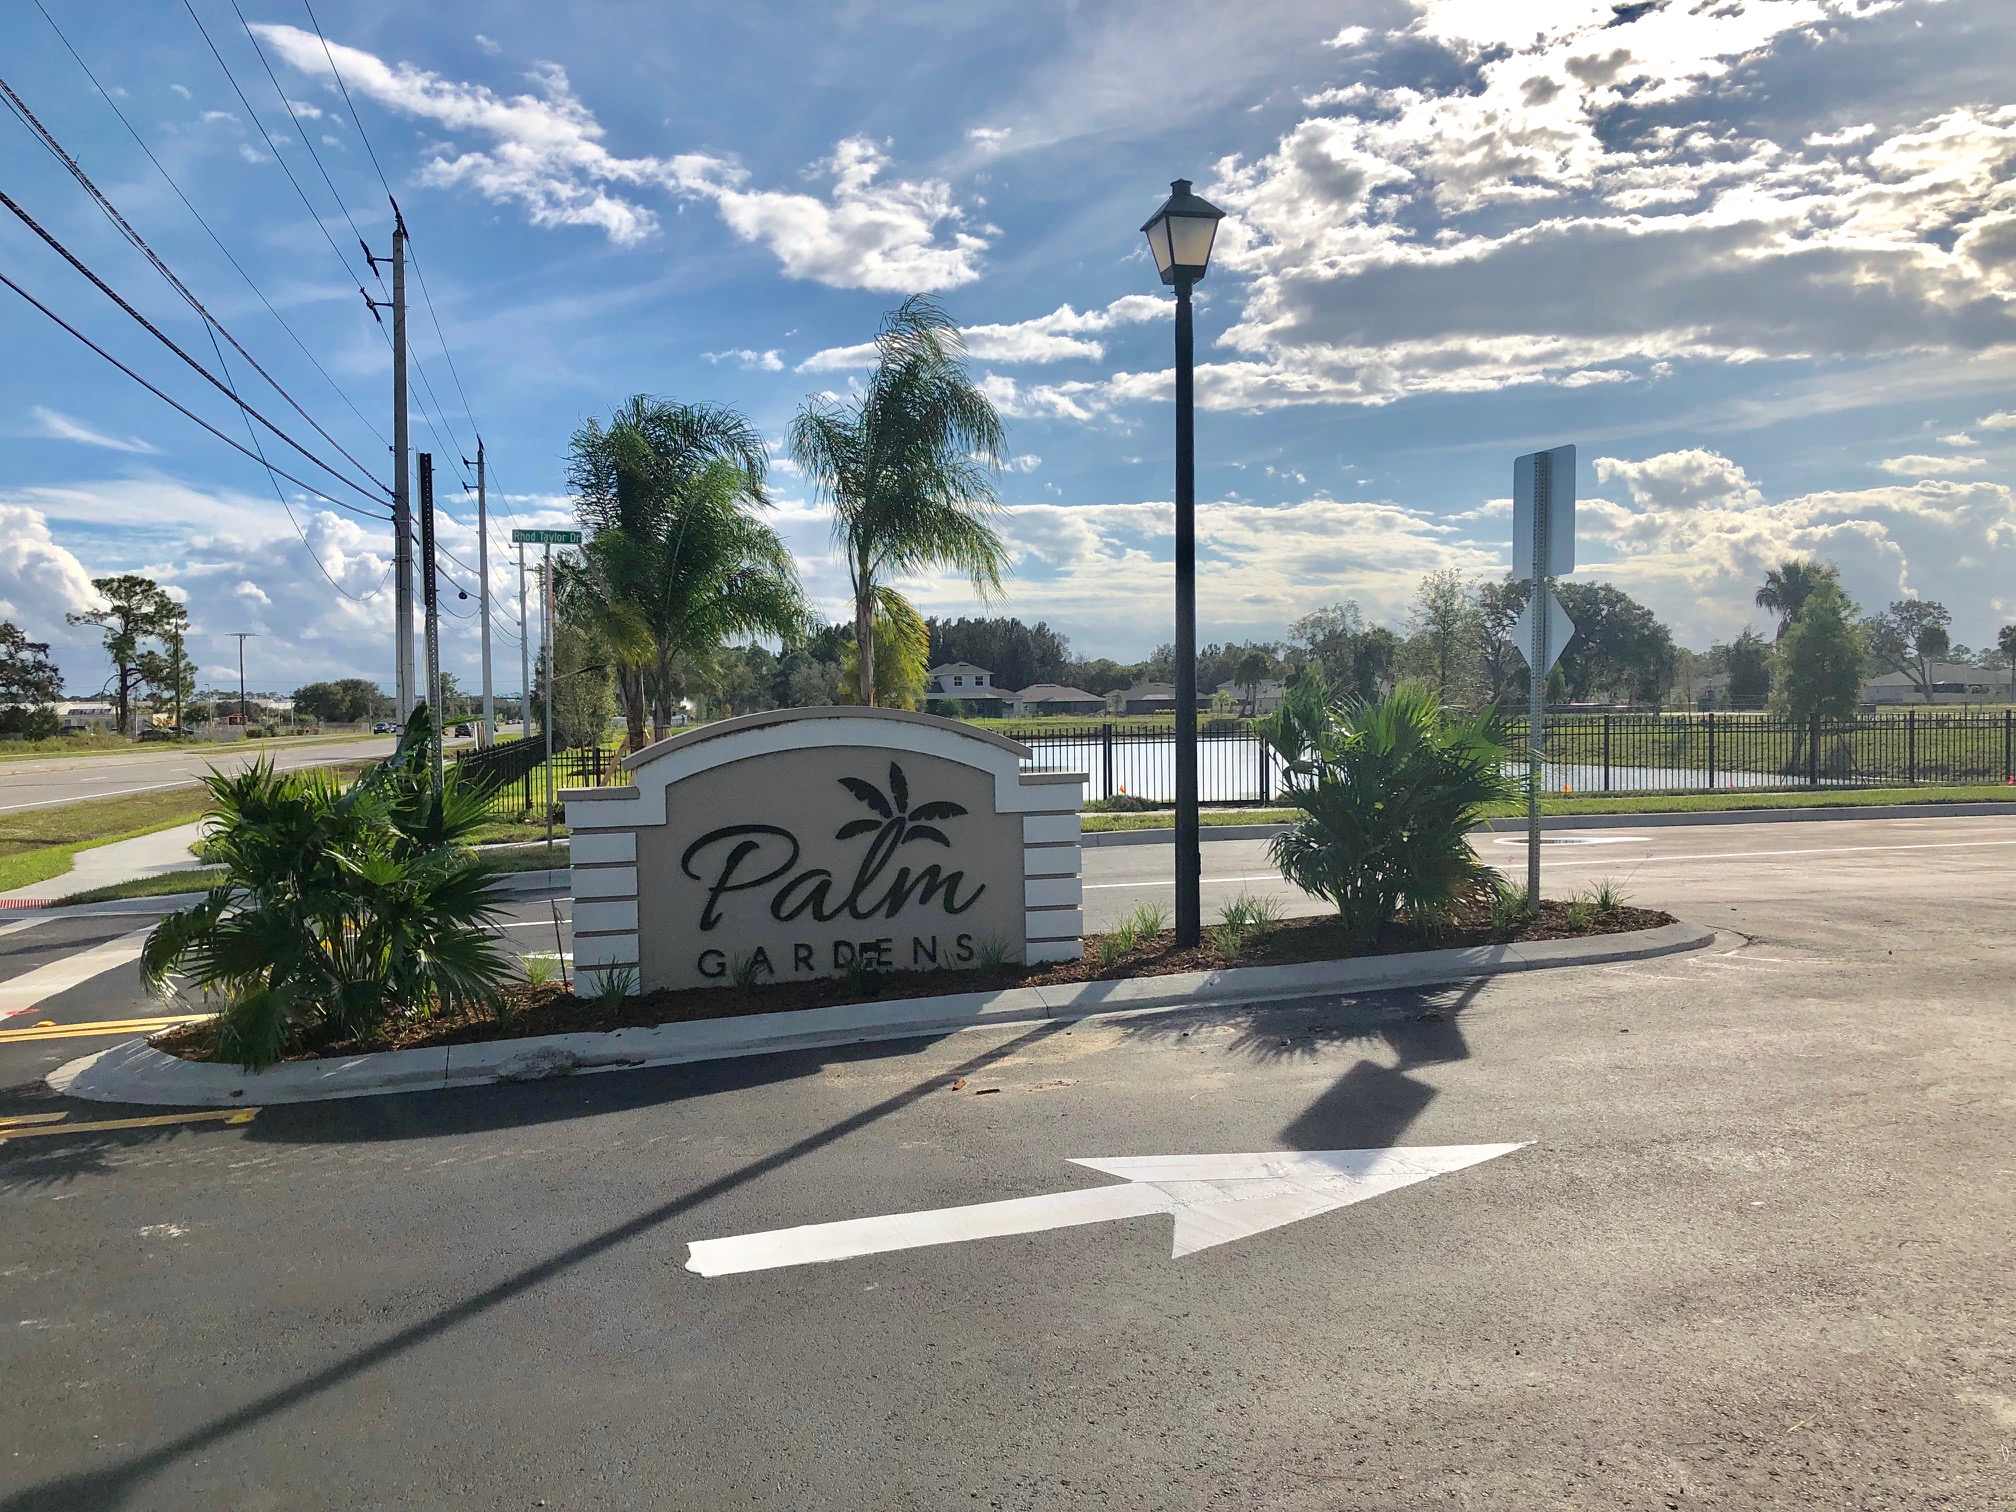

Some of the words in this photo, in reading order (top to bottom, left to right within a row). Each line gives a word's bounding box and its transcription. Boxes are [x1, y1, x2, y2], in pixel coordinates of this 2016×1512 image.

[514, 531, 536, 542] Rhod
[540, 531, 566, 543] Taylor
[570, 532, 581, 543] Dr
[681, 815, 986, 931] Palm
[697, 934, 976, 979] GARDENS
